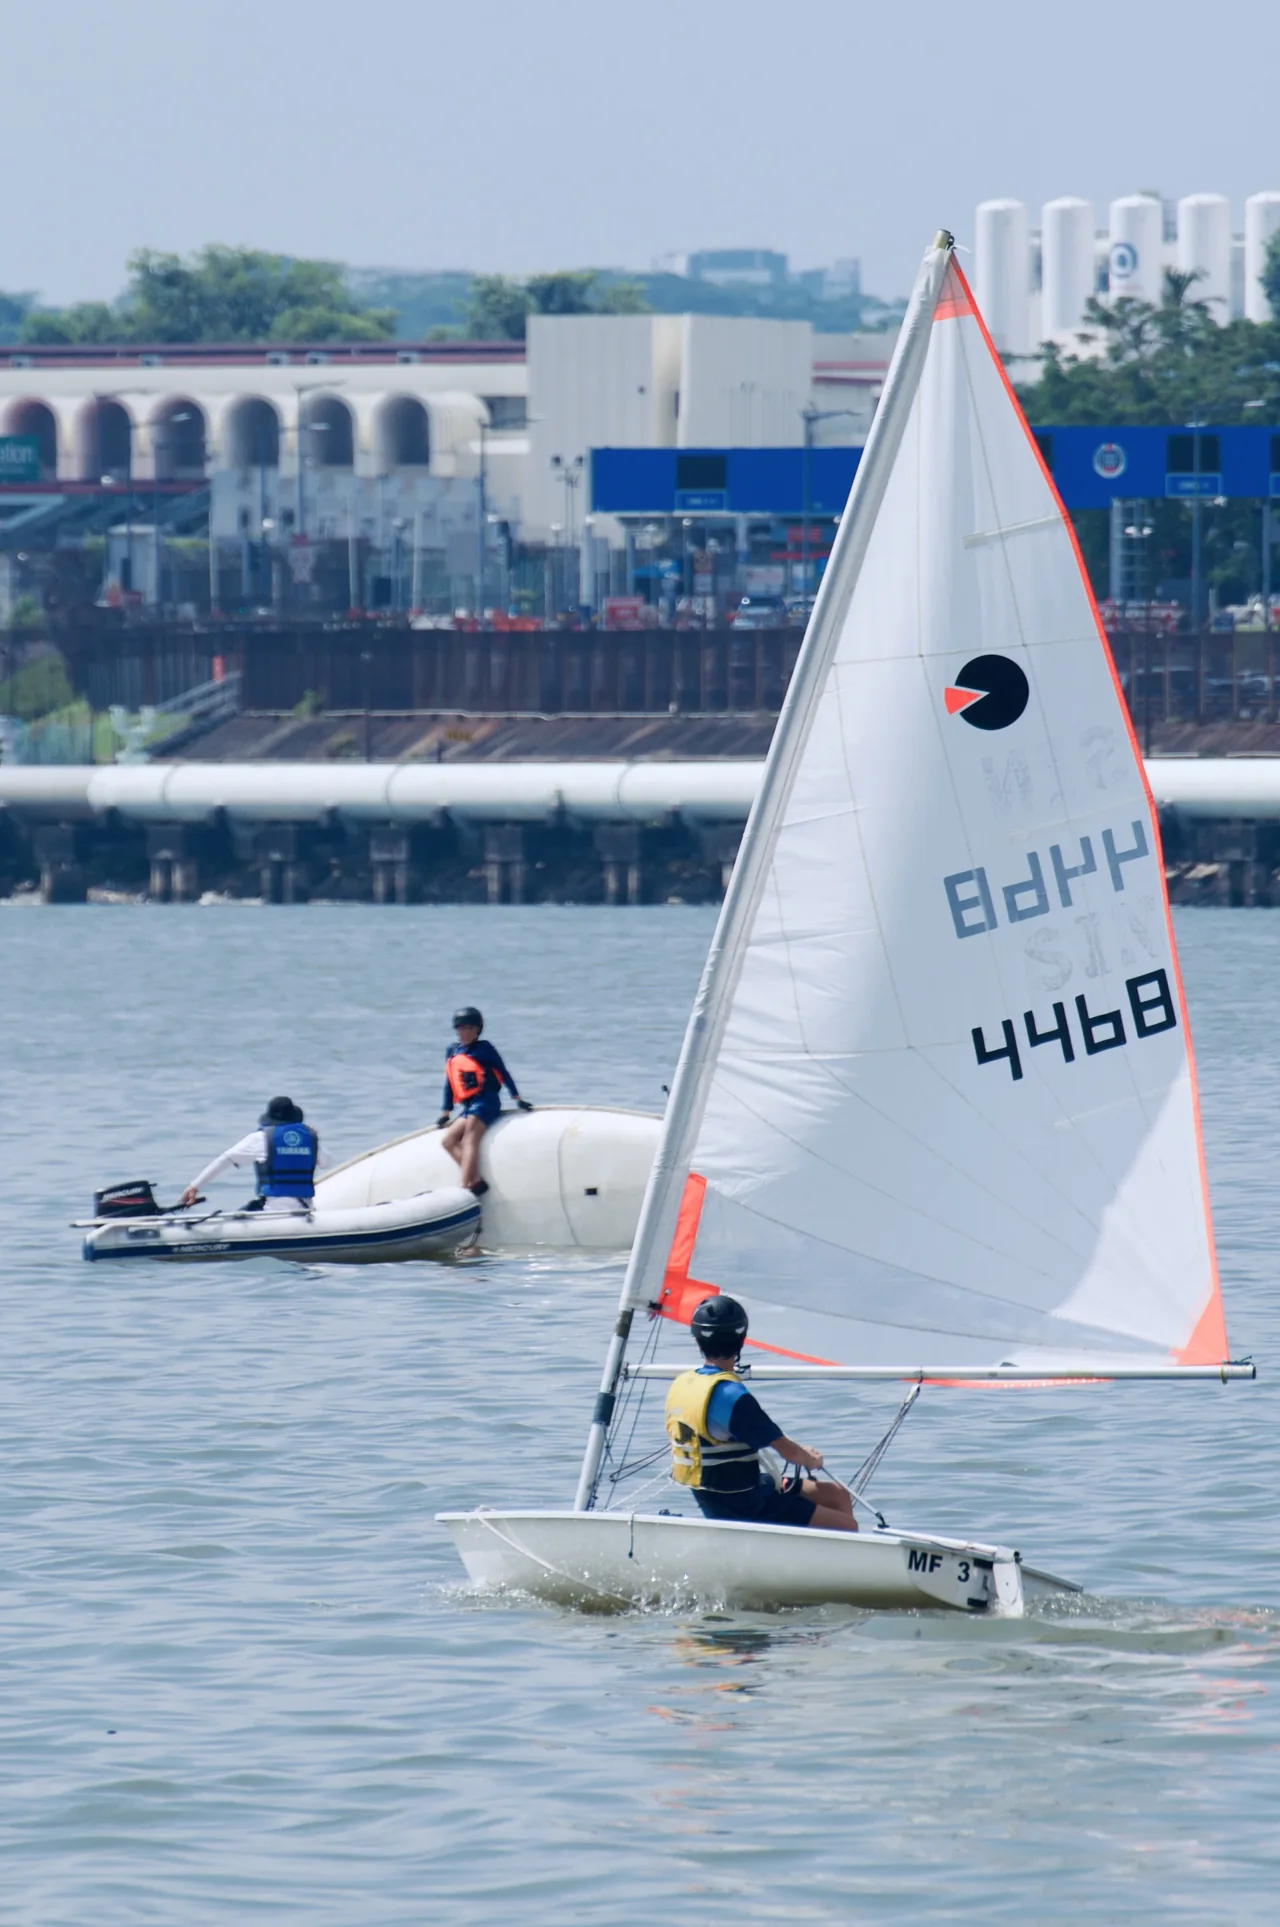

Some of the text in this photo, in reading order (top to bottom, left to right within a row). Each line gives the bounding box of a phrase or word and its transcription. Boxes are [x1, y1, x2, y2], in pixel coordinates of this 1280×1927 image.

[971, 968, 1177, 1081] 4468
[180, 1243, 230, 1253] MERCURY
[907, 1549, 943, 1573] MF
